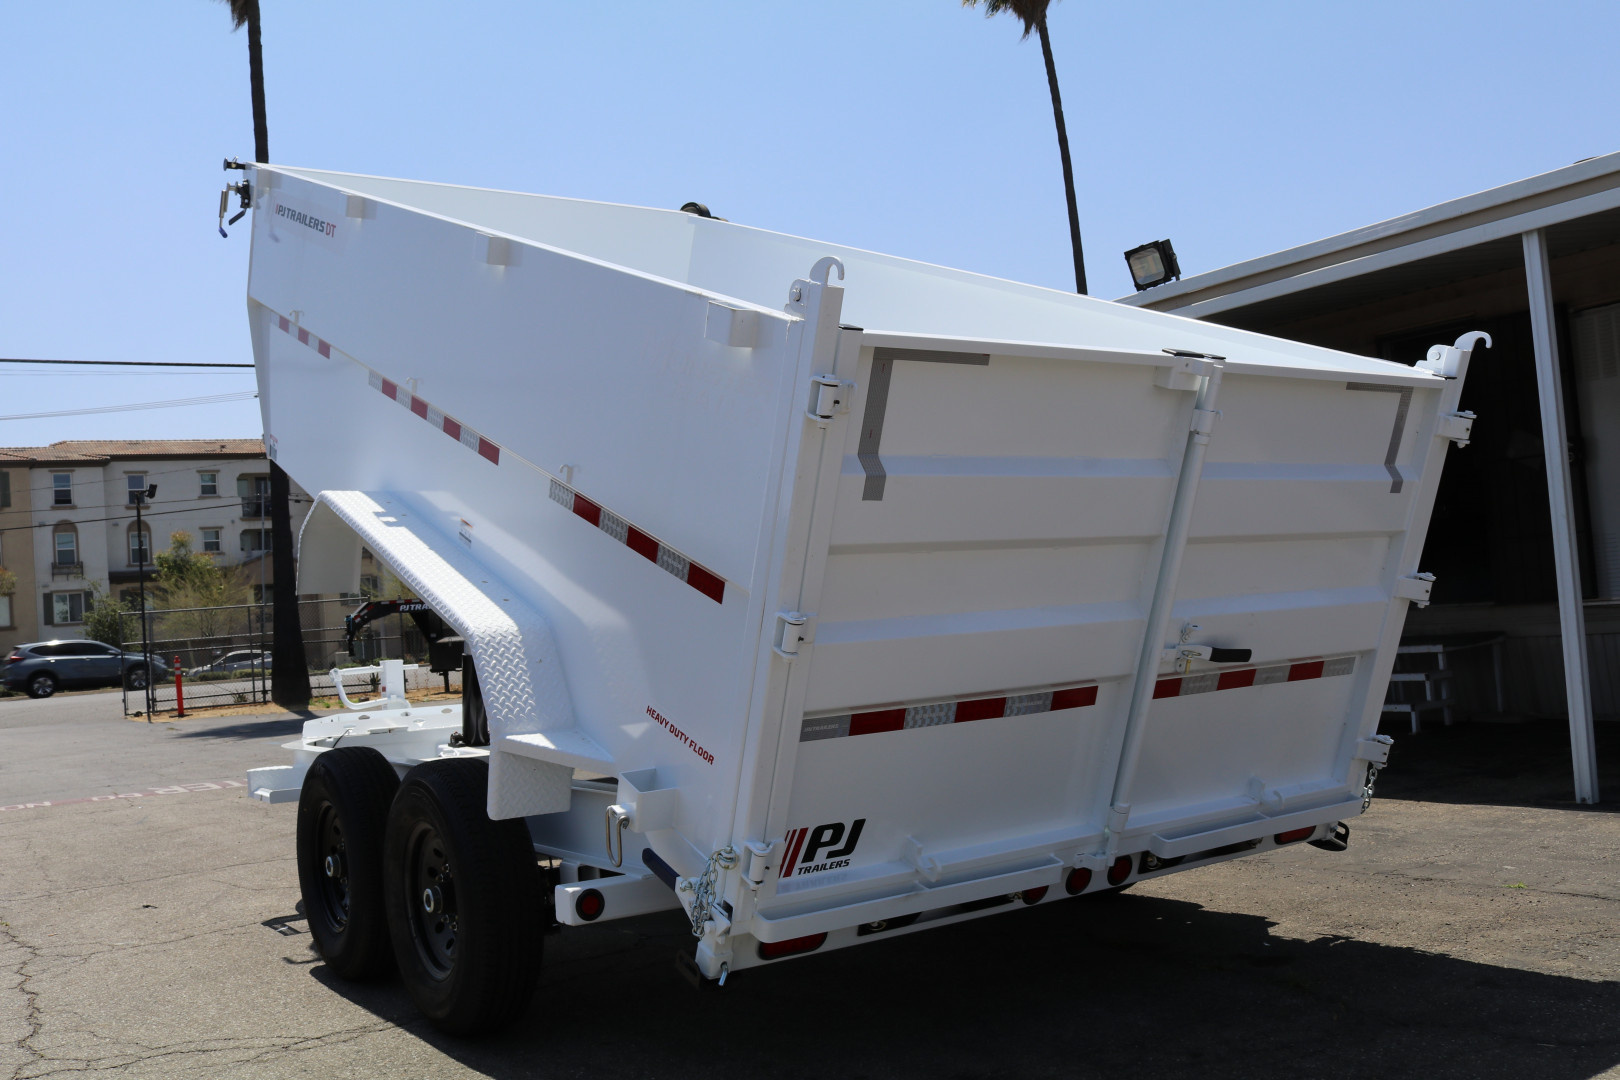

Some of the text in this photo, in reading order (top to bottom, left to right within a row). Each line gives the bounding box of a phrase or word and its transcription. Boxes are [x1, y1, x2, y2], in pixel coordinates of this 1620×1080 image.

[646, 705, 715, 766] HEAVY DUTY FLOOR
[801, 818, 867, 864] PJ
[797, 858, 851, 876] TRAILERS
